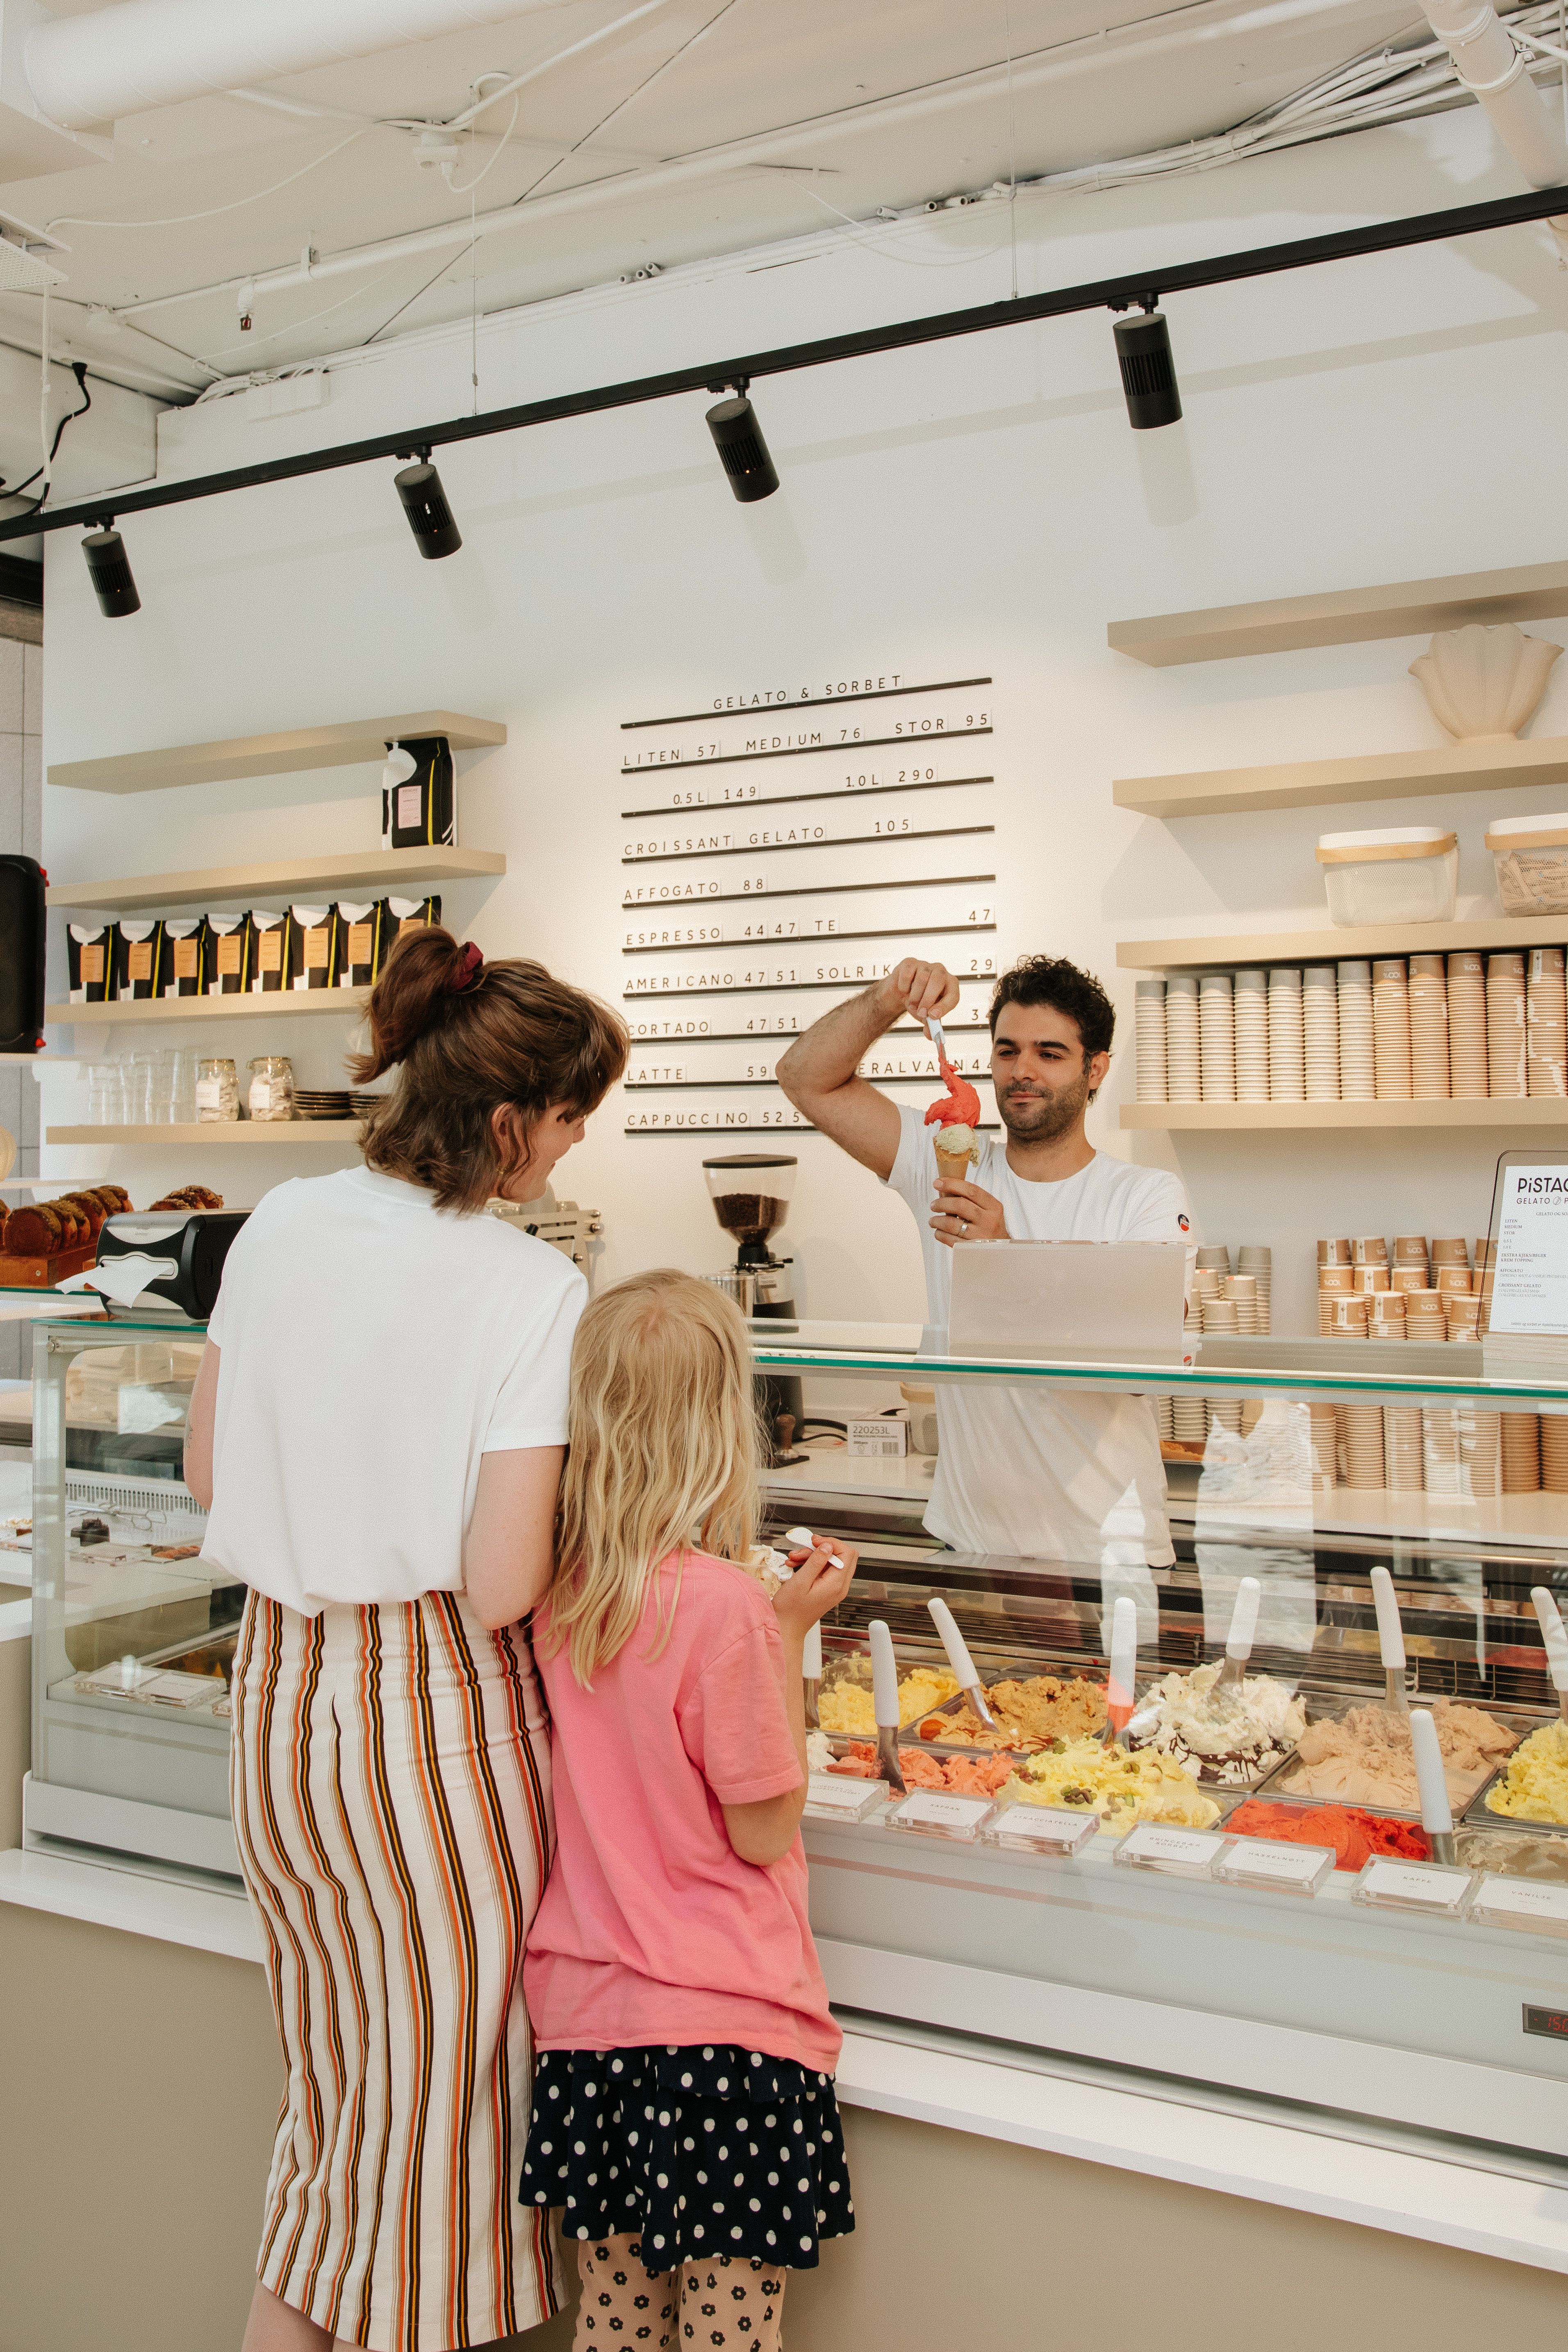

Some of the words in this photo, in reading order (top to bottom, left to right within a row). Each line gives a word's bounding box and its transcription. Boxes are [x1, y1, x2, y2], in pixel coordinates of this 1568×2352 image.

[714, 690, 786, 709] GELATO
[801, 688, 809, 699] &
[826, 675, 901, 695] SORBET
[624, 749, 680, 765] LITEN
[698, 745, 716, 757] 57
[746, 732, 821, 751] MEDIUM
[840, 728, 860, 741] 76
[896, 719, 944, 734] STOR
[966, 713, 987, 726] 95
[724, 786, 756, 799] 149
[899, 768, 933, 782] 290
[625, 835, 731, 855] CROISSANT
[750, 827, 823, 845] GELATO
[875, 819, 908, 833] 105
[624, 882, 718, 900] AFFOGATO
[744, 879, 763, 891] 88
[815, 920, 835, 931] TE
[969, 909, 990, 922] 47
[627, 928, 720, 945] ESPRESSO
[744, 925, 763, 937] 44
[775, 923, 795, 934] 47
[971, 959, 992, 971] 29
[626, 974, 733, 990] AMERICANO
[745, 972, 764, 983] 47
[777, 970, 796, 982] 51
[628, 1022, 708, 1036] CORTADO
[747, 1019, 766, 1031] 47
[778, 1017, 797, 1029] 51
[628, 1068, 682, 1081] LATTE
[747, 1066, 767, 1077] 59
[628, 1113, 748, 1126] CAPPUCCINO
[762, 1111, 782, 1123] 52
[793, 1112, 799, 1122] 5
[1013, 1815, 1077, 1826] STRACCIATELLA
[1512, 1890, 1551, 1900] VANILJE
